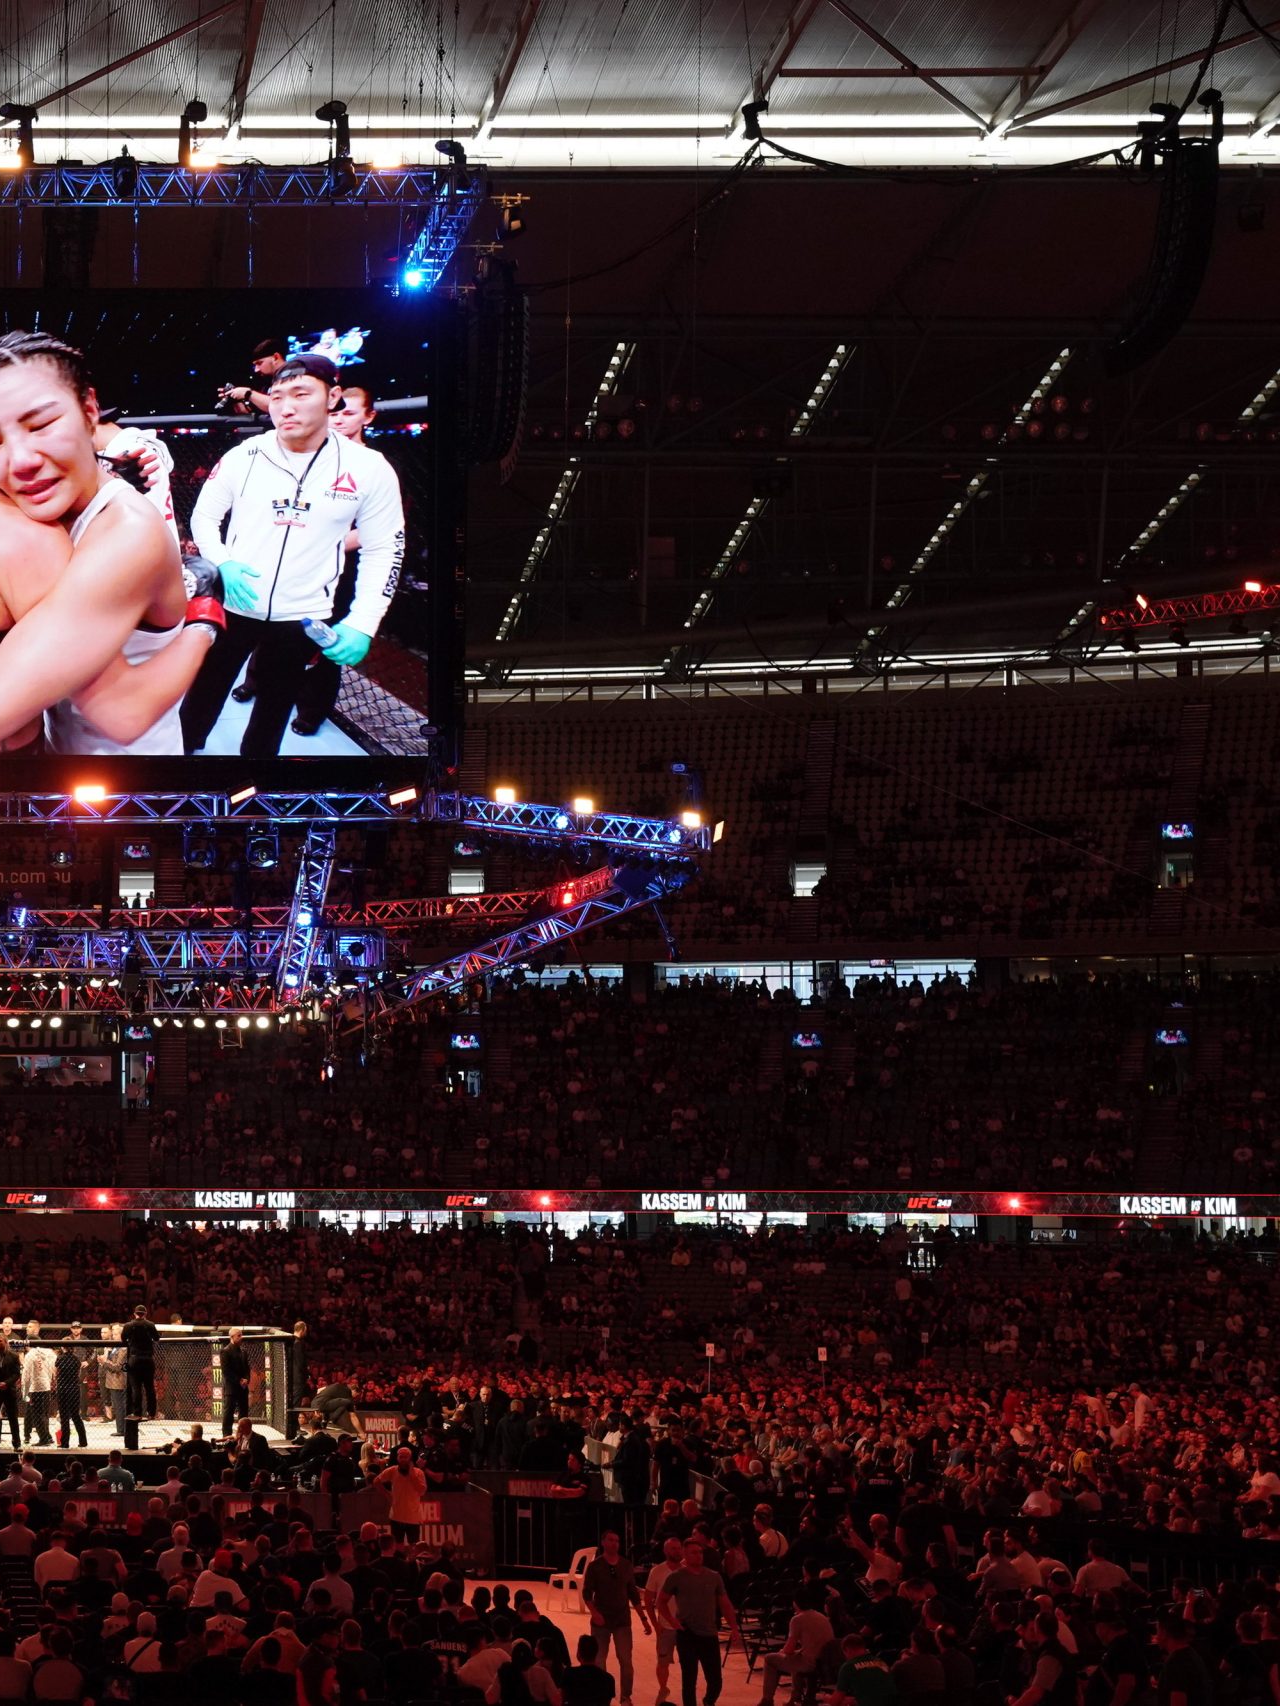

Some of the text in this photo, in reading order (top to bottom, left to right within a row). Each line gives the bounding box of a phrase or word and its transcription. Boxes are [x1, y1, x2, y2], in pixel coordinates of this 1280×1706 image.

[5, 1193, 47, 1204] UFC 243
[194, 1191, 253, 1208] KASSEM
[267, 1191, 296, 1208] KIM
[445, 1195, 488, 1206] UFC 243
[641, 1193, 702, 1210] KASSEM
[717, 1193, 747, 1211] KIM
[907, 1198, 953, 1209] UFC 243
[1119, 1196, 1187, 1214] KASSEM
[1204, 1197, 1237, 1215] KIM
